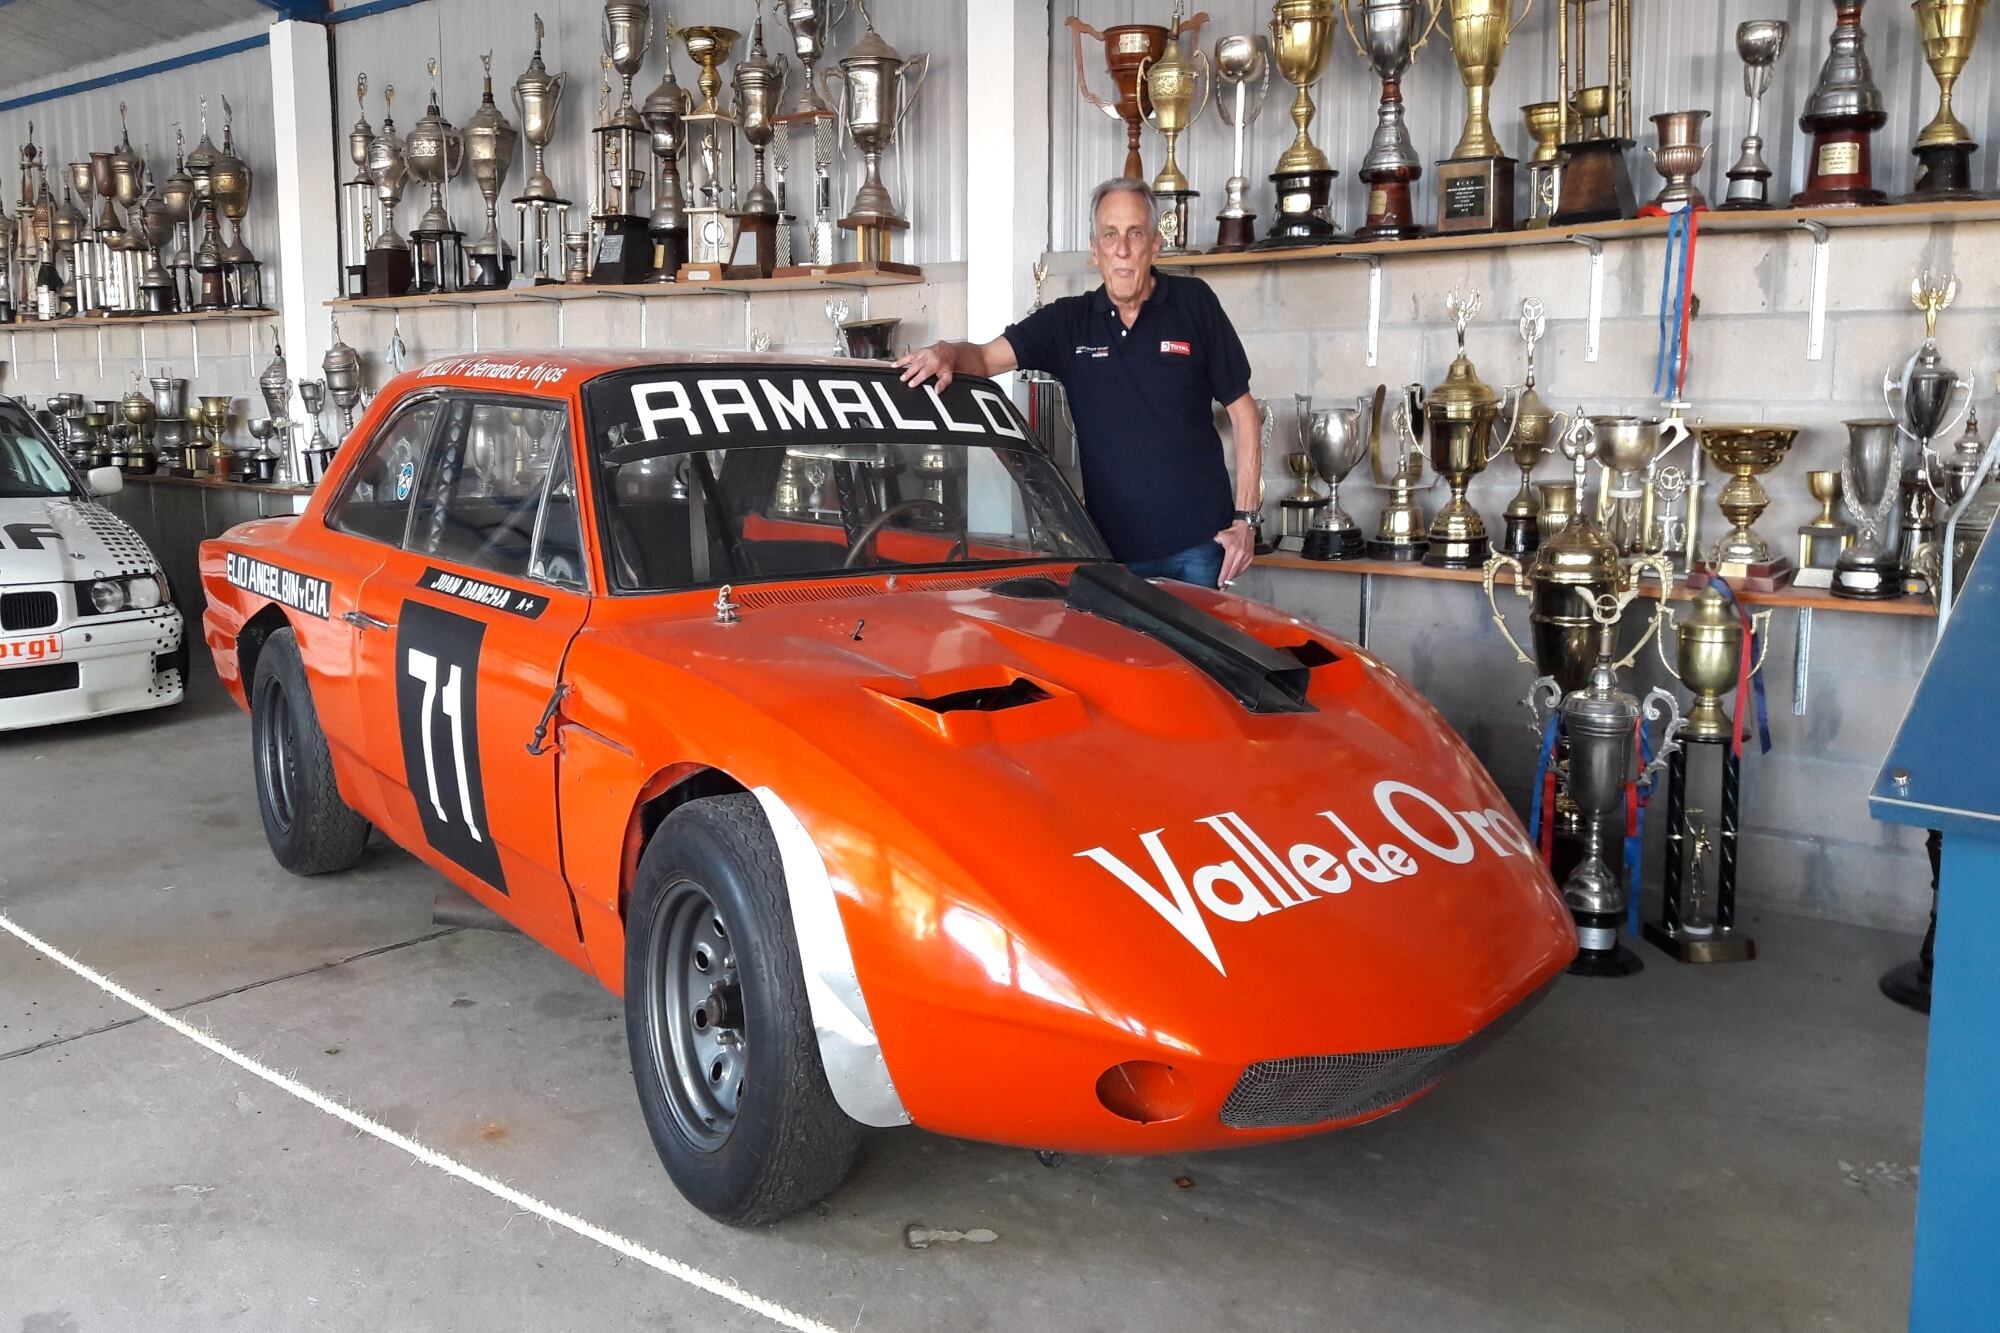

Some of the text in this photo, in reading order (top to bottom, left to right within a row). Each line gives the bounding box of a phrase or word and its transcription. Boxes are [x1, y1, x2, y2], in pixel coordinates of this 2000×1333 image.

[1170, 343, 1190, 352] TOTAL
[517, 366, 529, 379] e
[527, 362, 567, 389] hijos
[631, 378, 1026, 441] RAMALLO
[227, 553, 248, 588] ELIO
[247, 560, 281, 600] ANGEL
[281, 571, 299, 608] BIN
[430, 573, 534, 611] JUAN DANCHA A+
[408, 647, 482, 843] 71
[1073, 780, 1534, 978] Valle de Oro
